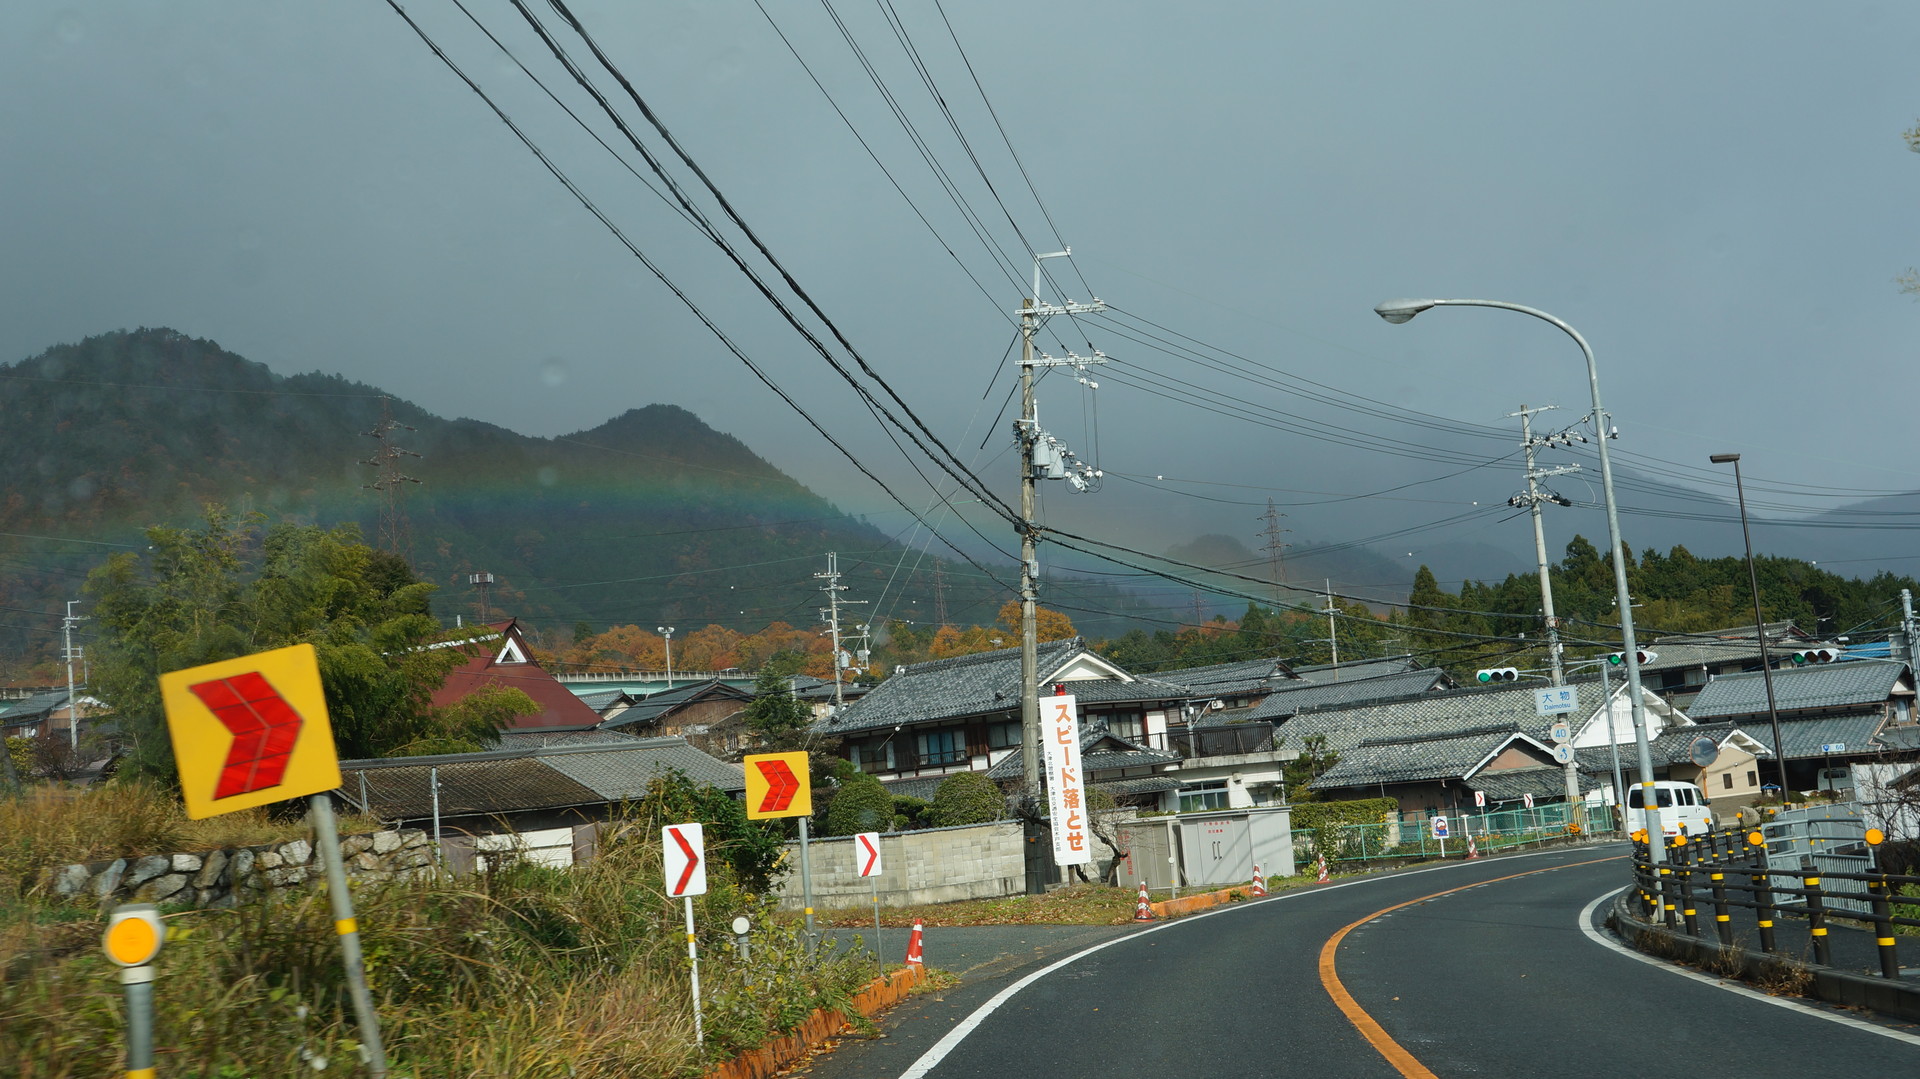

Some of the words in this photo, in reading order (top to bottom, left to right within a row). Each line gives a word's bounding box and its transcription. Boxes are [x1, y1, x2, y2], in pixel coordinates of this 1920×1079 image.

[1542, 691, 1570, 704] 大物
[1544, 703, 1571, 711] Daimotsu
[1555, 728, 1567, 738] 40
[1055, 704, 1083, 851] スピード落とせ
